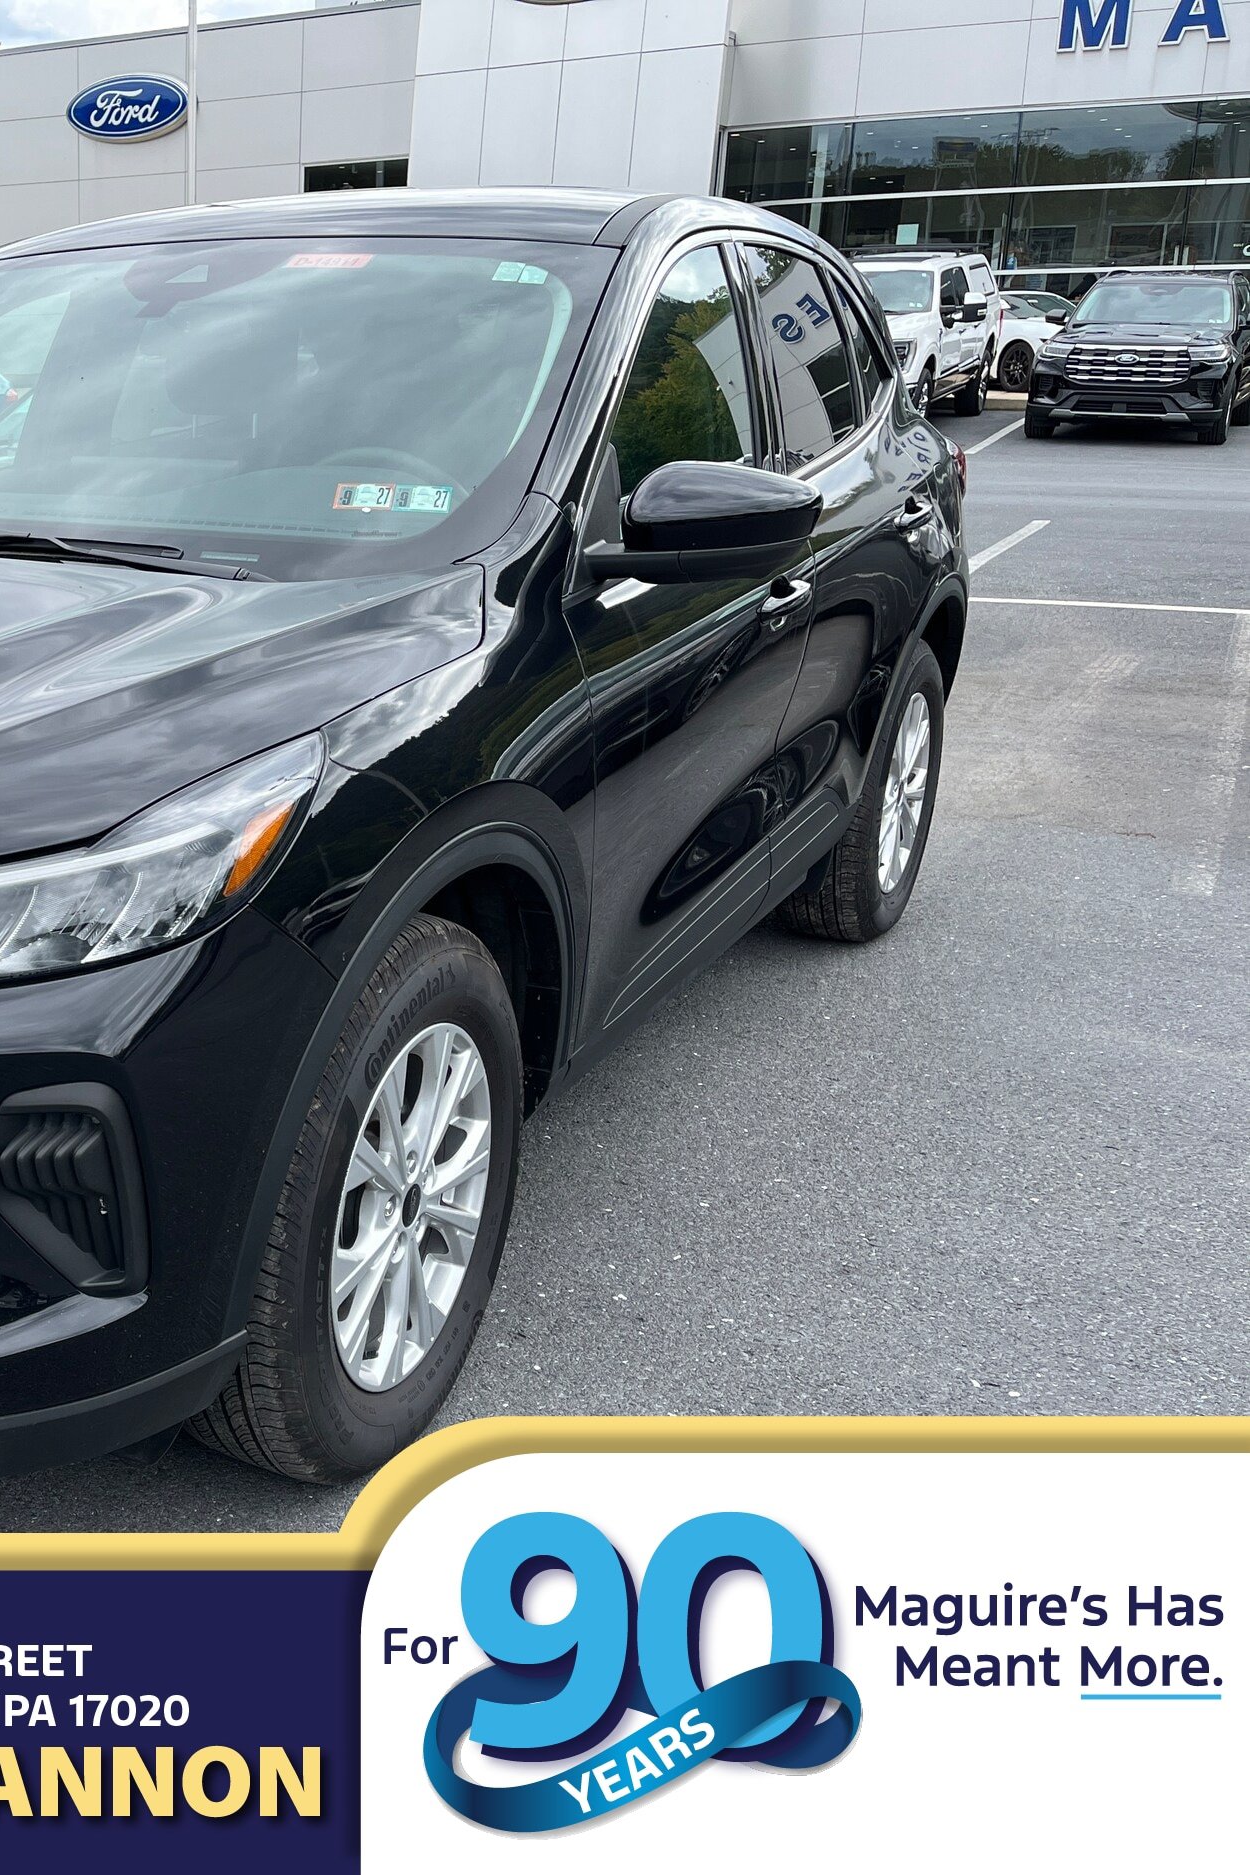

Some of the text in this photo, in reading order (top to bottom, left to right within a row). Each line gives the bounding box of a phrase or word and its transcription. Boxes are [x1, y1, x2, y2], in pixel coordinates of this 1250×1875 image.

[90, 88, 161, 128] Ford
[376, 487, 391, 505] 27
[433, 490, 449, 509] 27
[364, 966, 447, 1090] Continental
